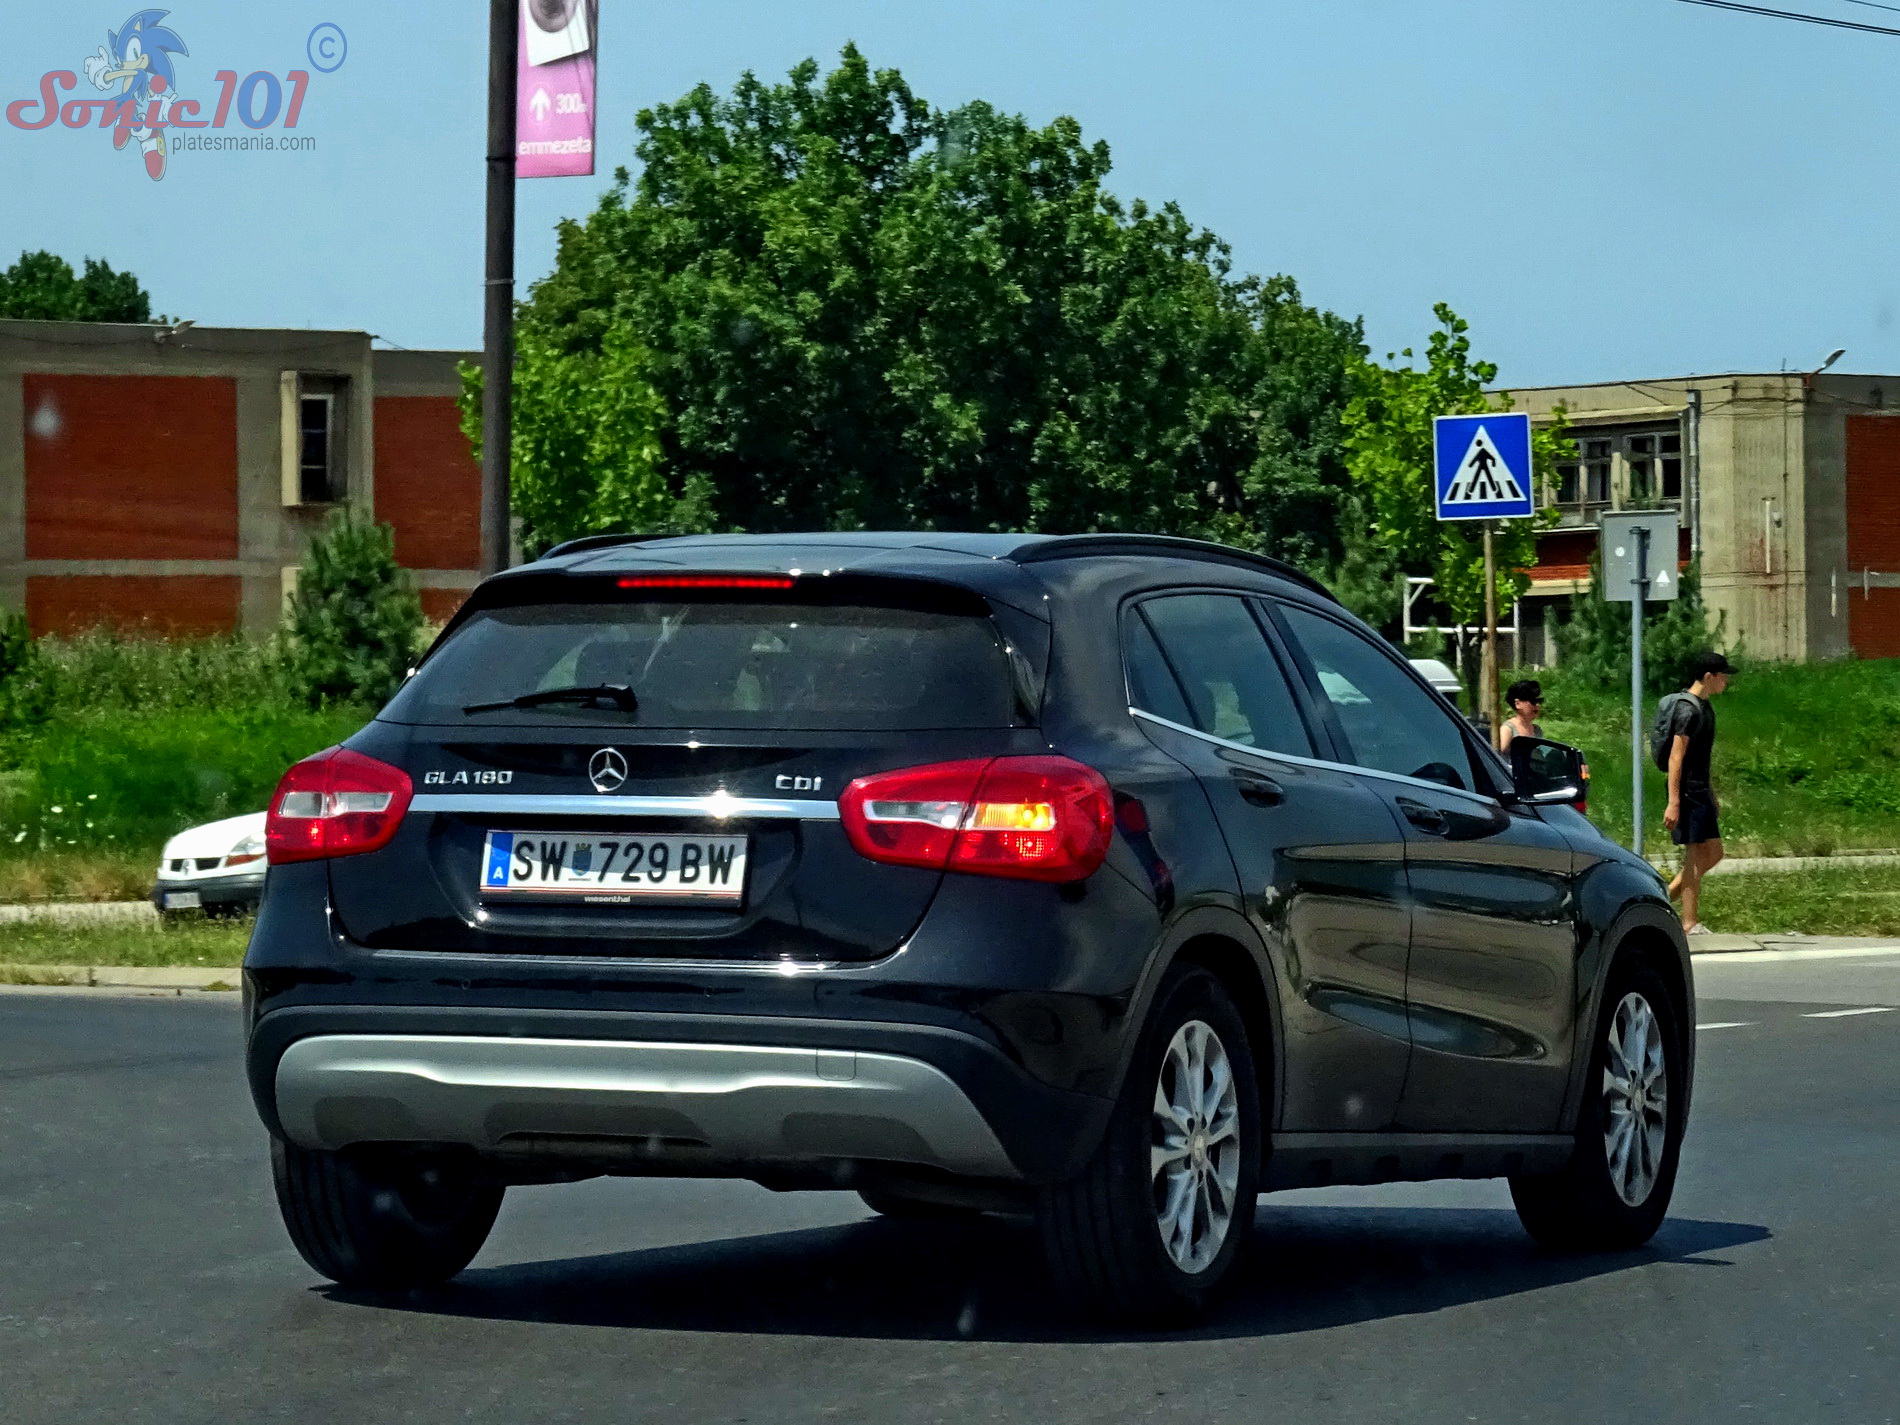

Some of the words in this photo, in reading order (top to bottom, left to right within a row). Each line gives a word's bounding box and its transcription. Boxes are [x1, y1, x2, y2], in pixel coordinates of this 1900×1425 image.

[519, 136, 592, 155] emmezeta
[424, 771, 468, 784] GLA
[473, 771, 513, 784] 180
[512, 840, 568, 882] SW
[596, 841, 670, 884] 729
[679, 842, 736, 885] BW
[493, 866, 504, 880] A
